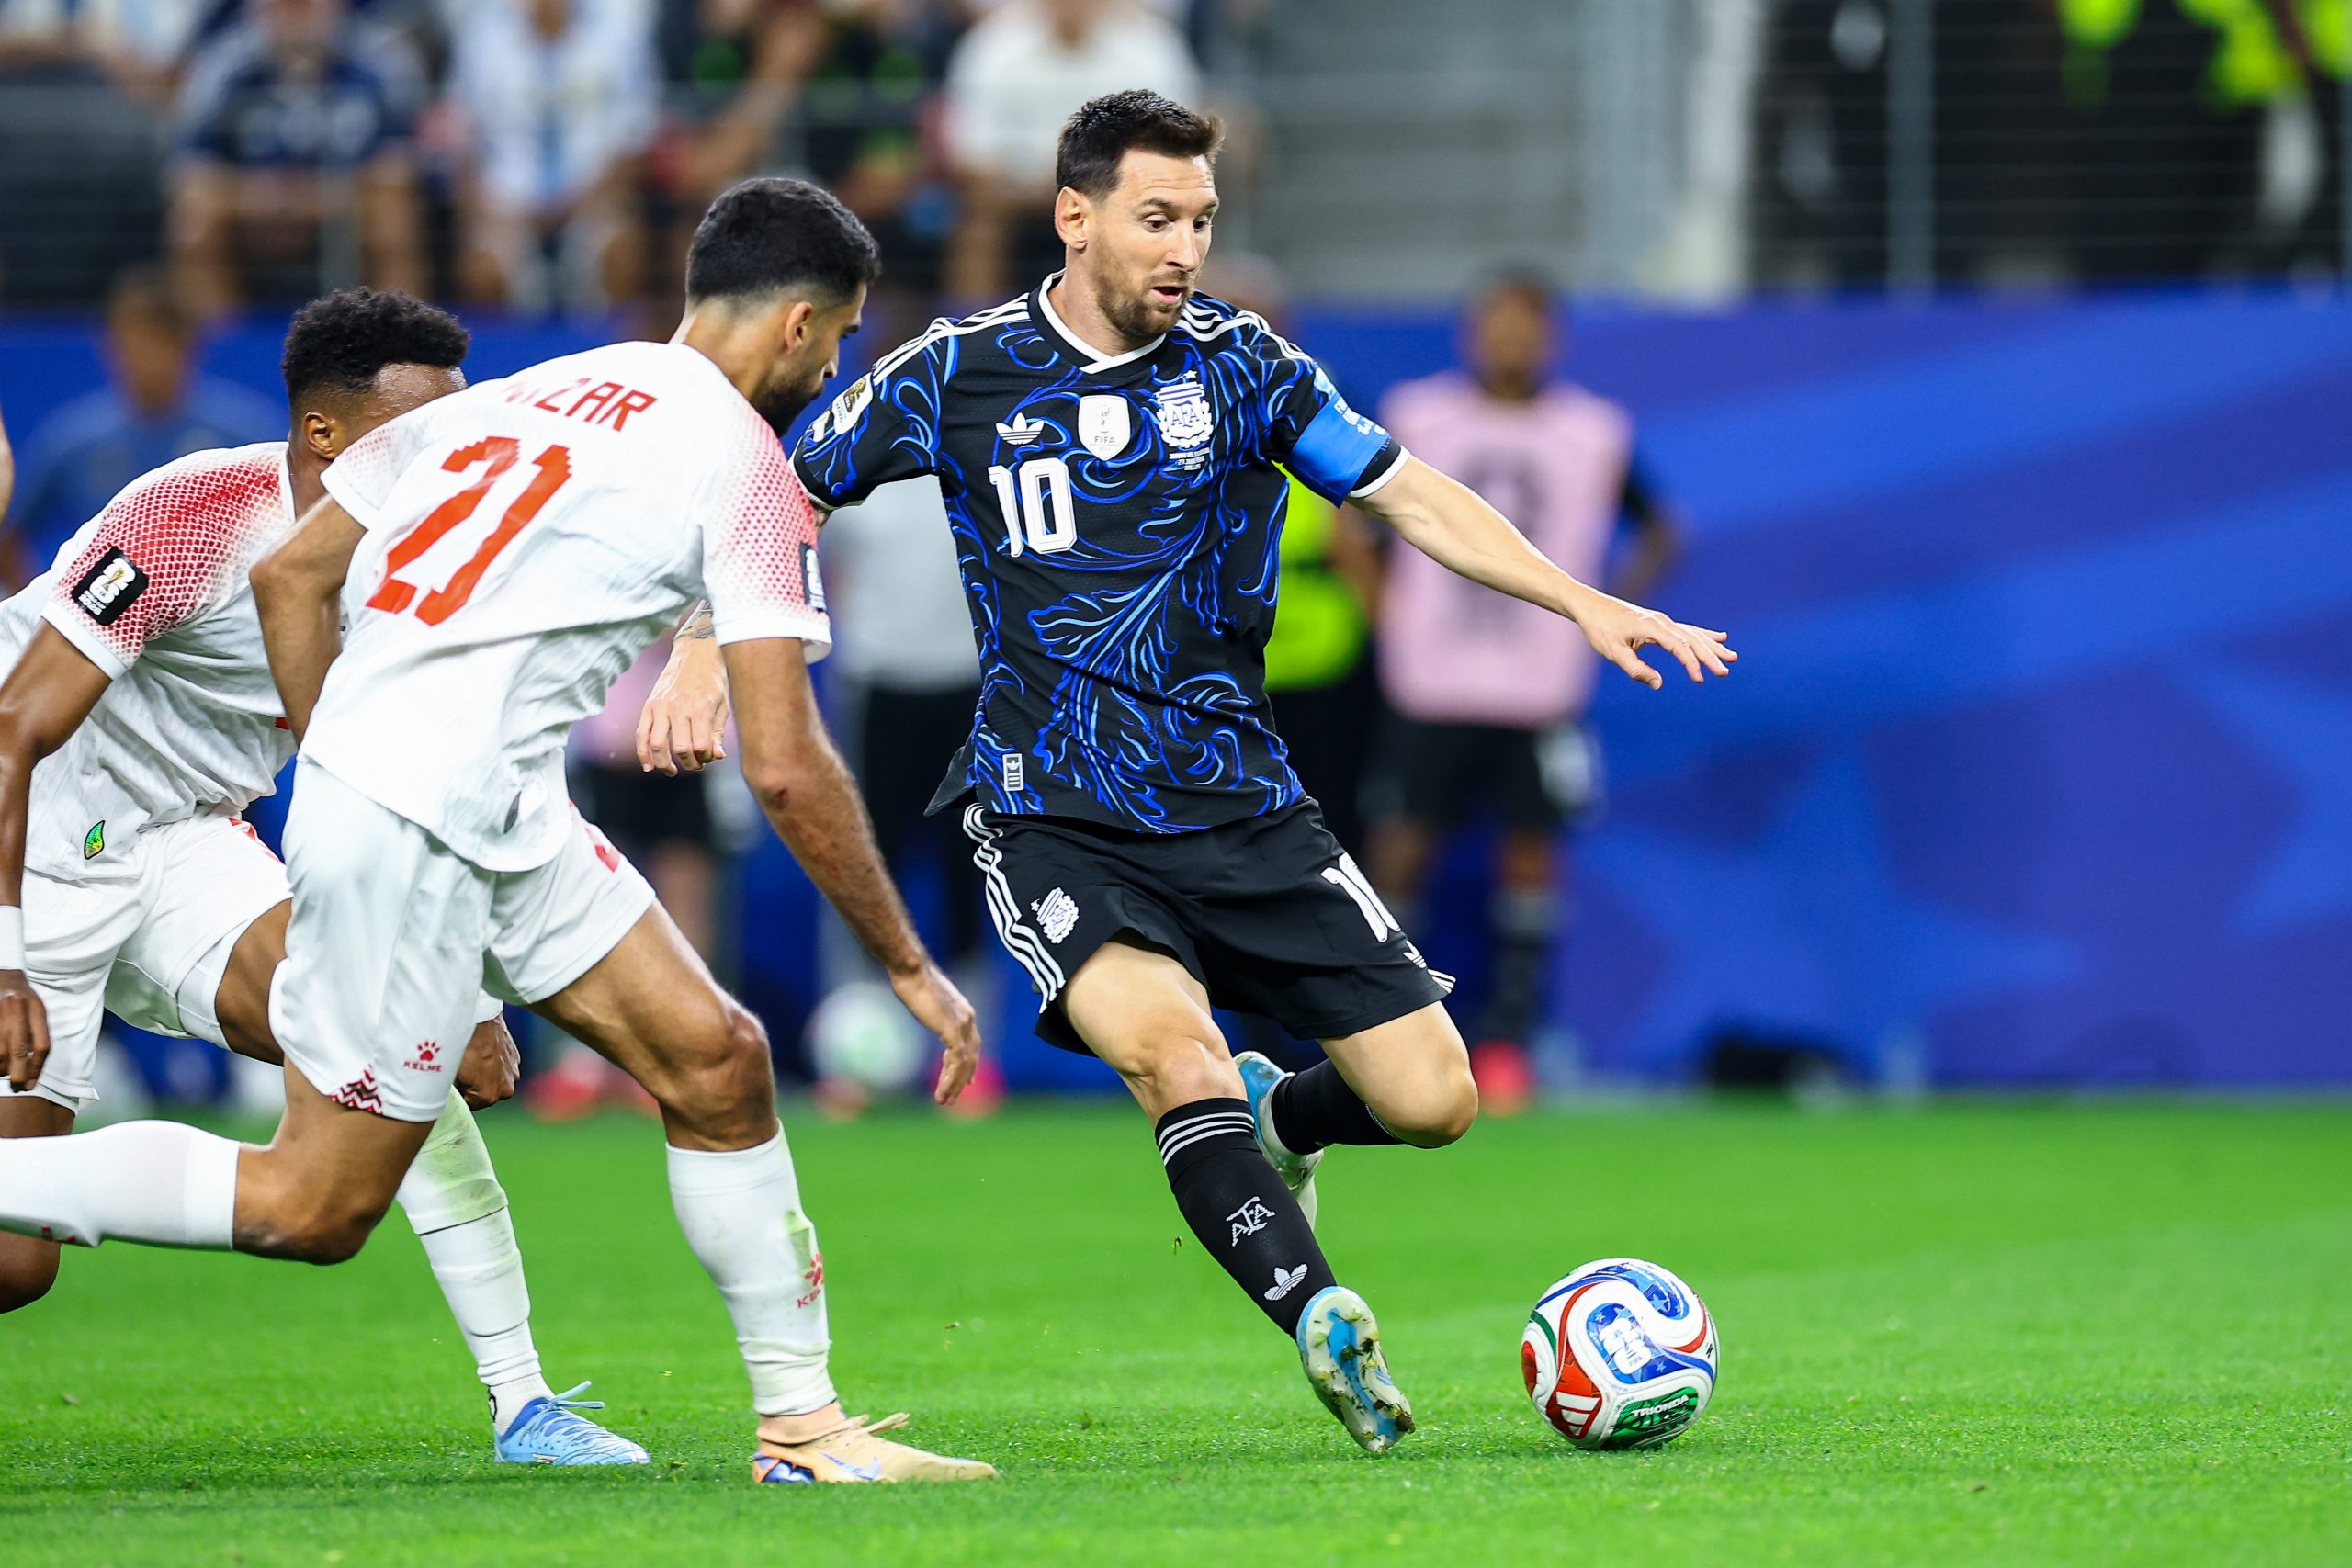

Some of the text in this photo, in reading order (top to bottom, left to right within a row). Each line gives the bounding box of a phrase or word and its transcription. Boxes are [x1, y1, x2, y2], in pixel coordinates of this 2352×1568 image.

[1094, 435, 1115, 444] FIFA
[987, 457, 1078, 558] 10
[365, 435, 572, 627] 21
[403, 1060, 442, 1073] KELME
[1225, 1195, 1276, 1247] AFA
[1631, 1393, 1690, 1417] TRIONDA
